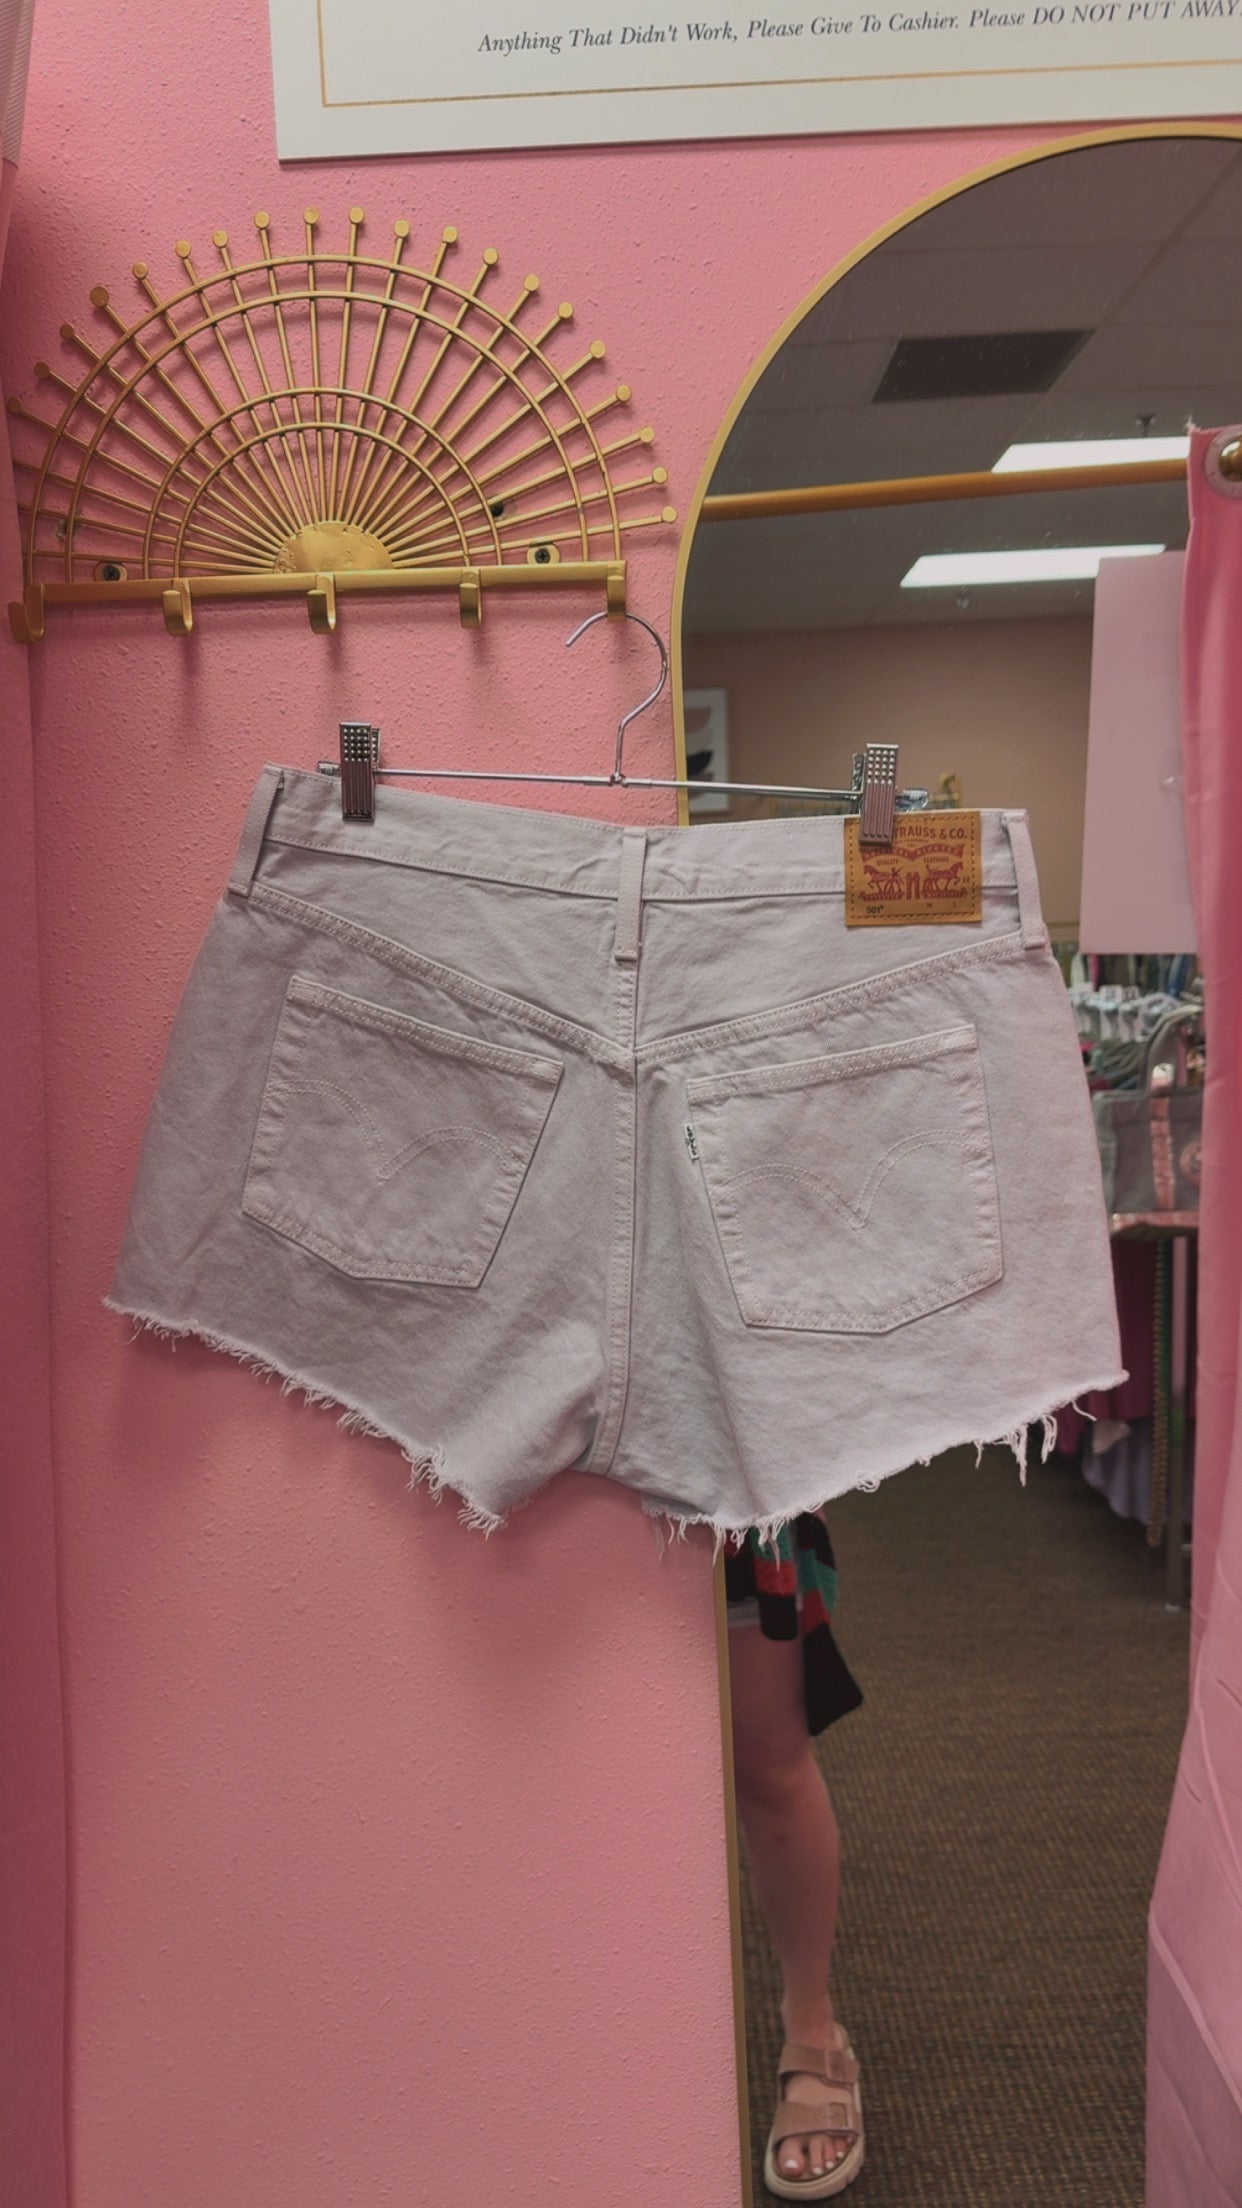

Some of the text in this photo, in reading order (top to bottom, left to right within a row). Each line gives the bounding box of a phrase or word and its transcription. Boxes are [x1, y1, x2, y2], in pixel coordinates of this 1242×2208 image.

[477, 31, 563, 57] Anything
[568, 28, 613, 47] That
[619, 24, 678, 45] Didn't
[686, 20, 738, 43] Work,
[746, 18, 804, 39] Please
[810, 16, 854, 36] Give
[860, 14, 882, 33] To
[889, 11, 959, 32] Cashier.
[968, 8, 1026, 29] Please
[1032, 6, 1066, 26] DO
[1071, 3, 1122, 24] NOT
[1127, 1, 1176, 21] PUT
[893, 826, 968, 840] TRAUSS & CO.
